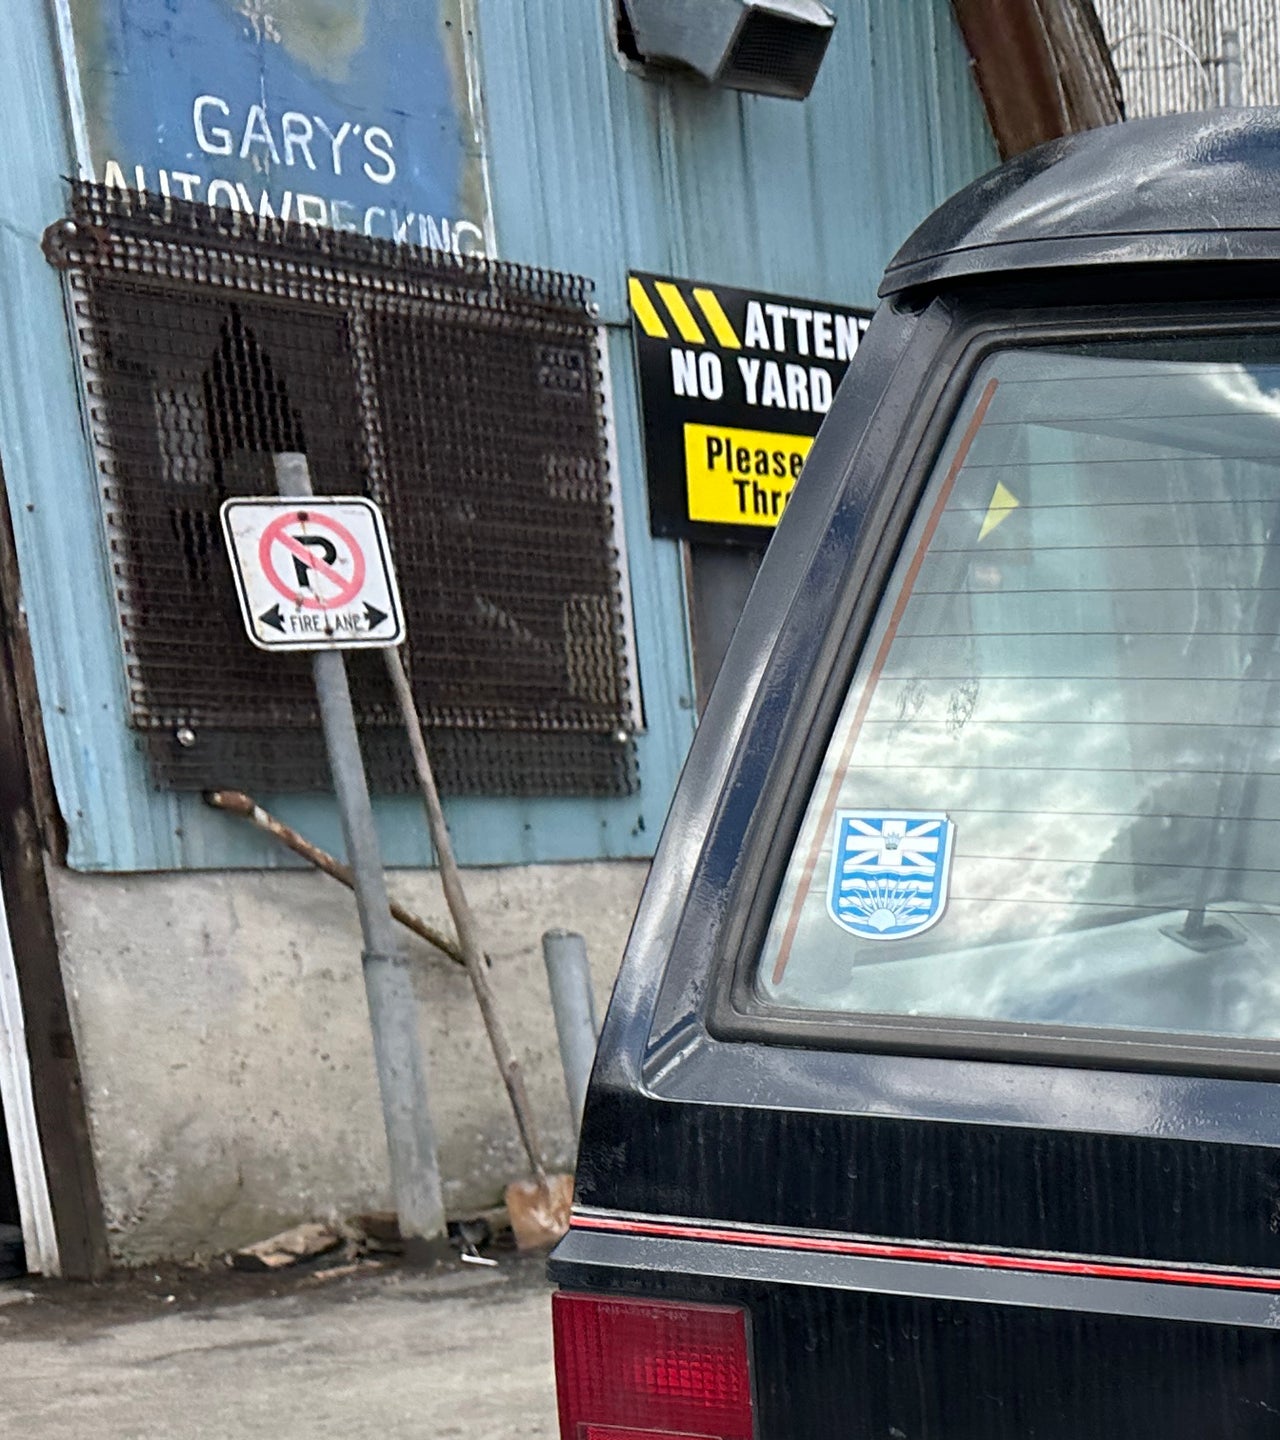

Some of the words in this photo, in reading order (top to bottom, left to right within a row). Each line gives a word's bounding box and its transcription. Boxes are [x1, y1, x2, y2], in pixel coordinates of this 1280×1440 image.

[192, 94, 396, 184] GARY'S
[670, 348, 724, 400] NO
[737, 356, 834, 414] YARD
[706, 435, 804, 478] Please
[290, 615, 322, 633] FIRE
